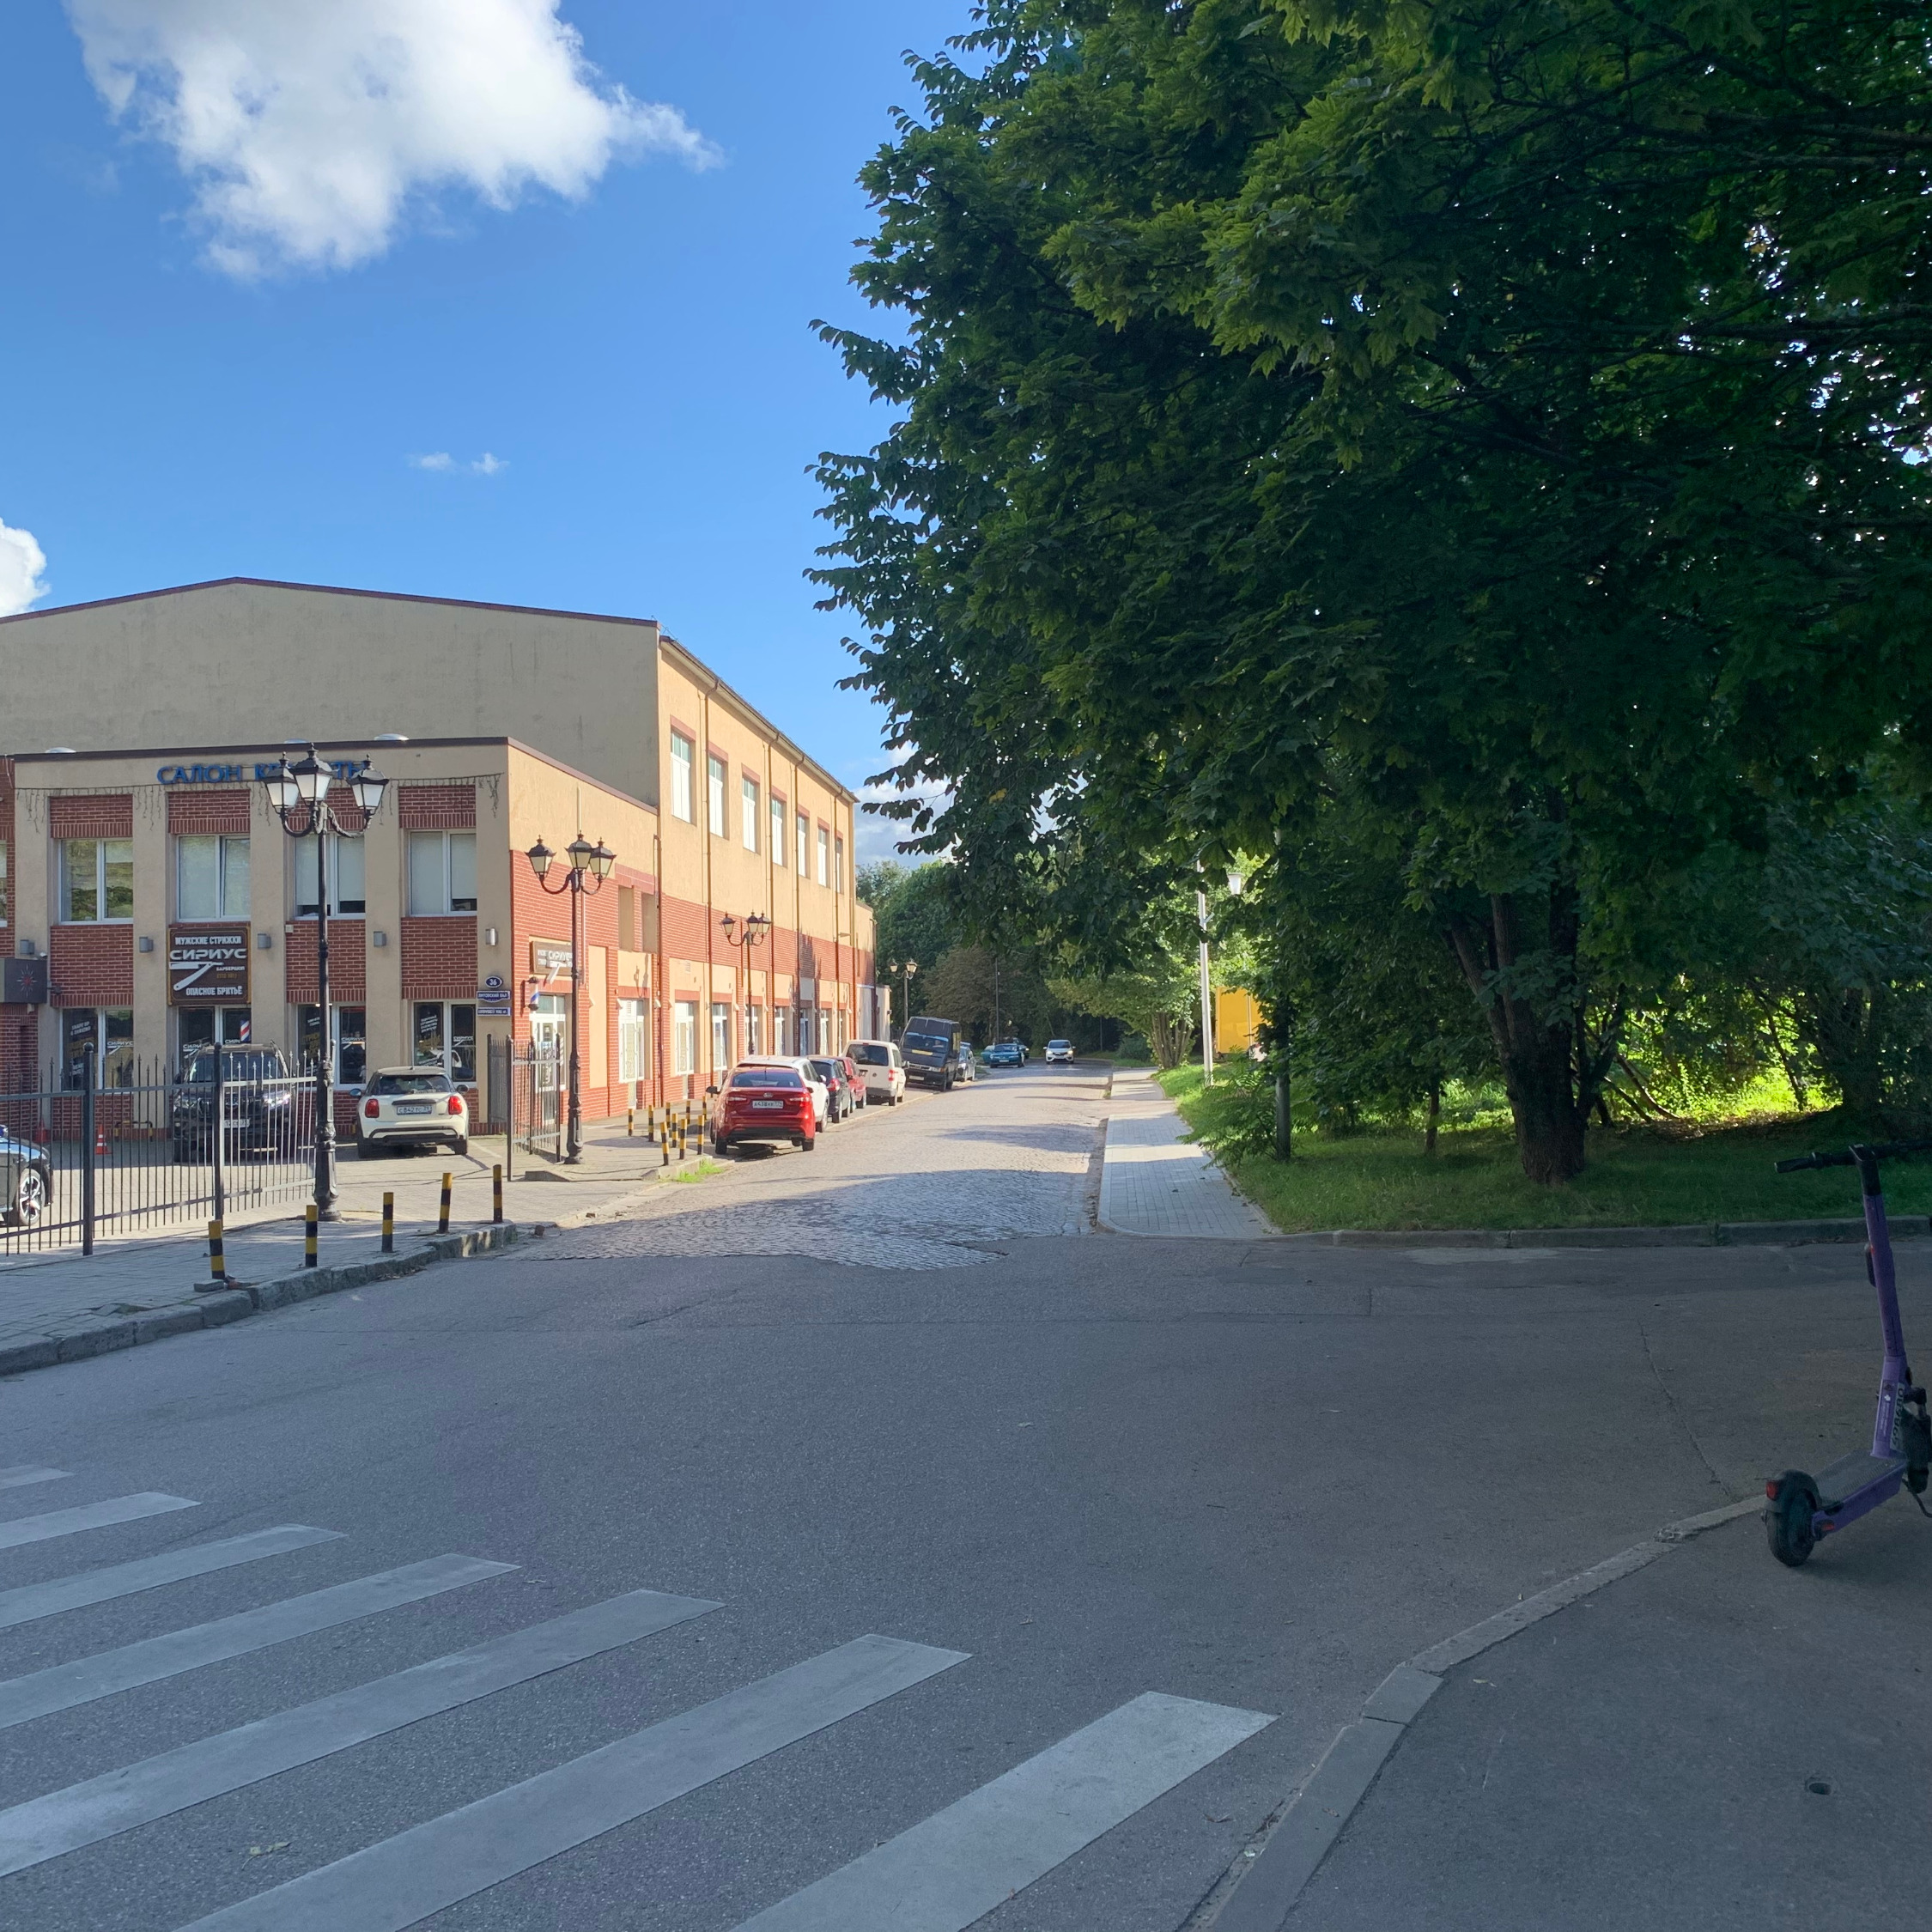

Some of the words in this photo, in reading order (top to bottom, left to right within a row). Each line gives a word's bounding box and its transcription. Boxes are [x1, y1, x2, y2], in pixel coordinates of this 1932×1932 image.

[156, 764, 242, 785] САЛОН
[175, 936, 208, 945] МУЖСКИЕ
[210, 936, 241, 945] СТРИЖКИ
[169, 948, 247, 960] СИРИУС
[185, 987, 216, 996] ОПАСНОЕ
[216, 986, 243, 995] БРИТЬЁ
